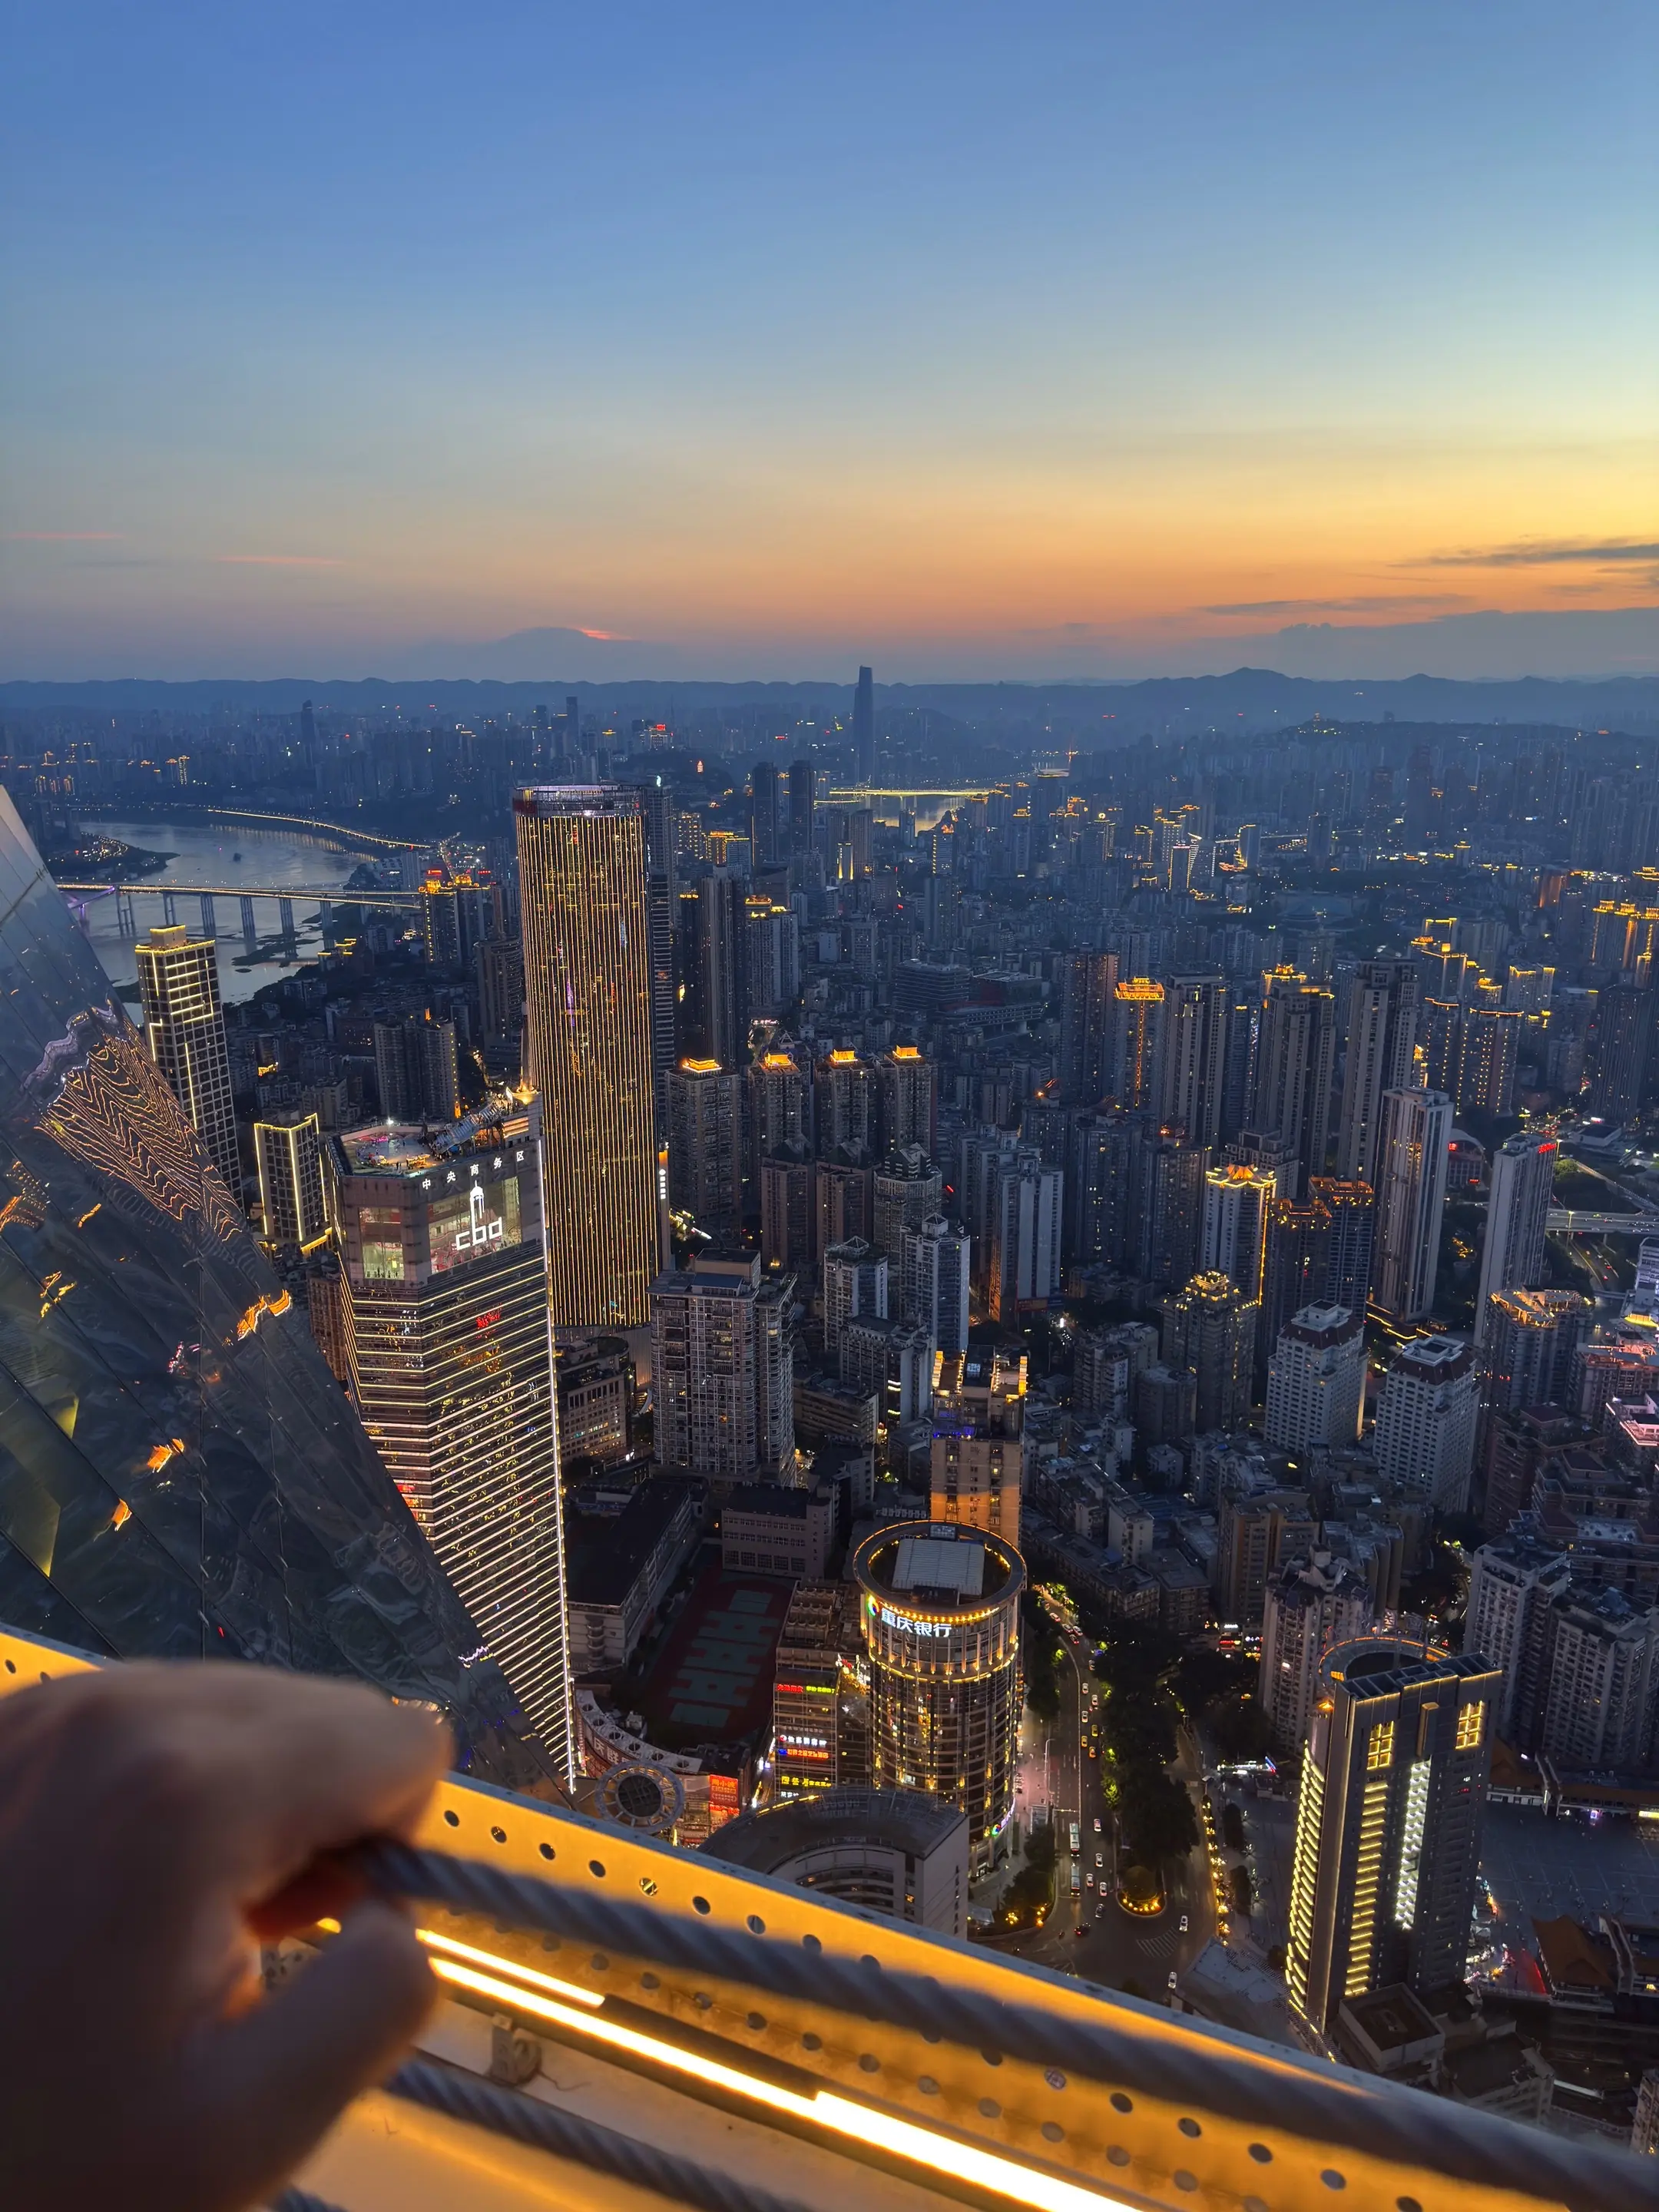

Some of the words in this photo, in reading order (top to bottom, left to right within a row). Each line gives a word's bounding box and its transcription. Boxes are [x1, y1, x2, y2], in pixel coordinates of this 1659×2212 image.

[422, 1151, 525, 1190] 中央商务区
[880, 1608, 952, 1638] 重庆银行
